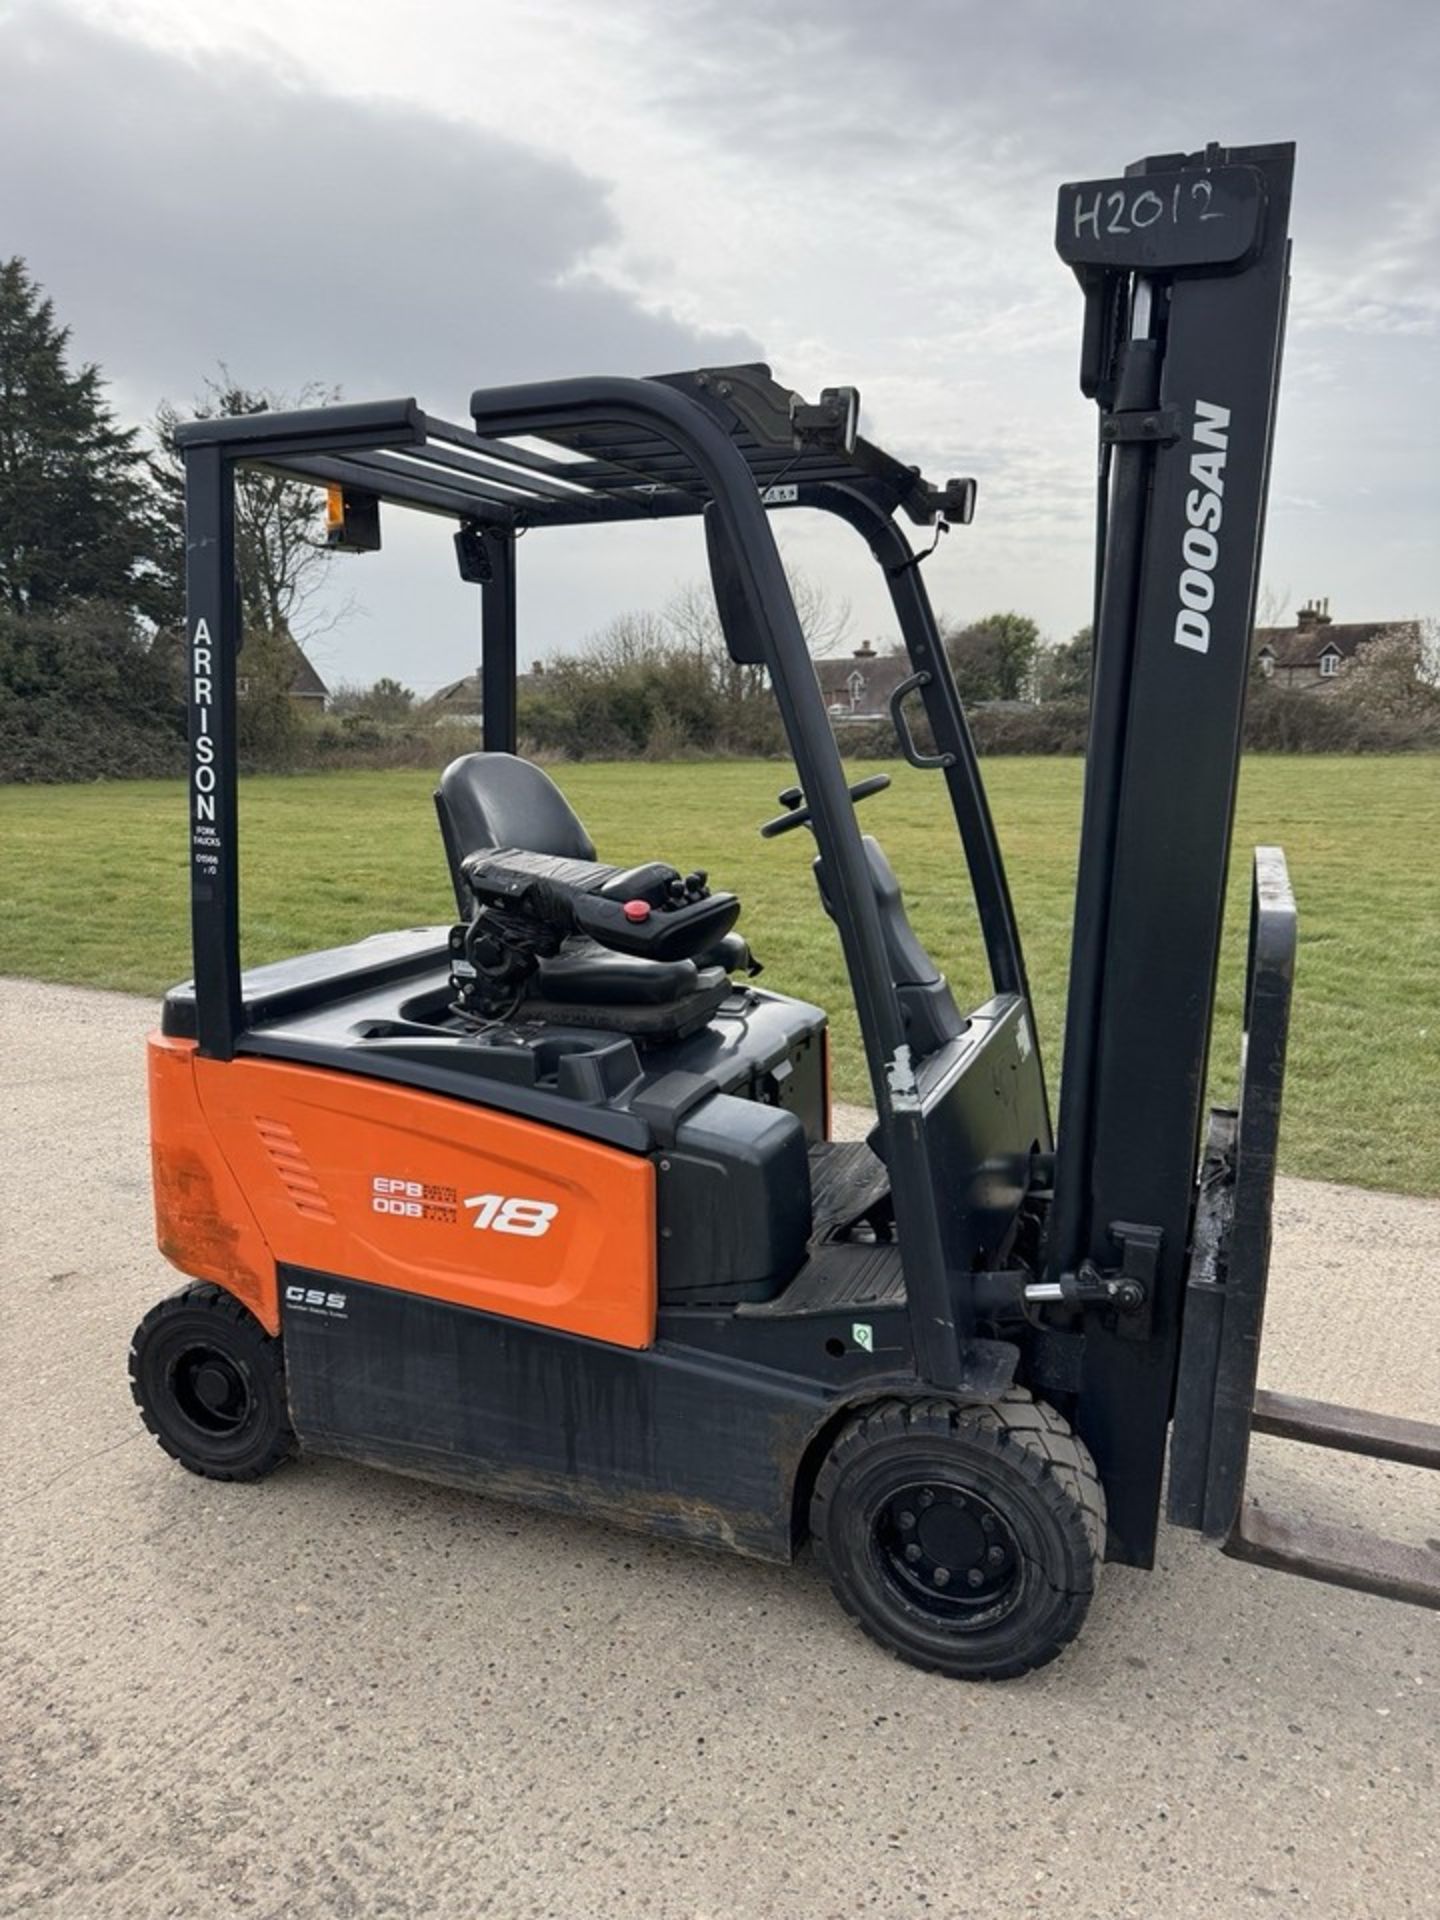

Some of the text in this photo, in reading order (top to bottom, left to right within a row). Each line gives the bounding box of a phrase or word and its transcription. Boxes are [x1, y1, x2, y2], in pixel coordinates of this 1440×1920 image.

[1074, 180, 1225, 240] H2012
[1174, 399, 1231, 654] DOOSAN
[193, 617, 215, 821] ARRISON
[373, 1177, 423, 1197] EPB
[464, 1194, 559, 1237] 18
[286, 1286, 347, 1309] GSS
